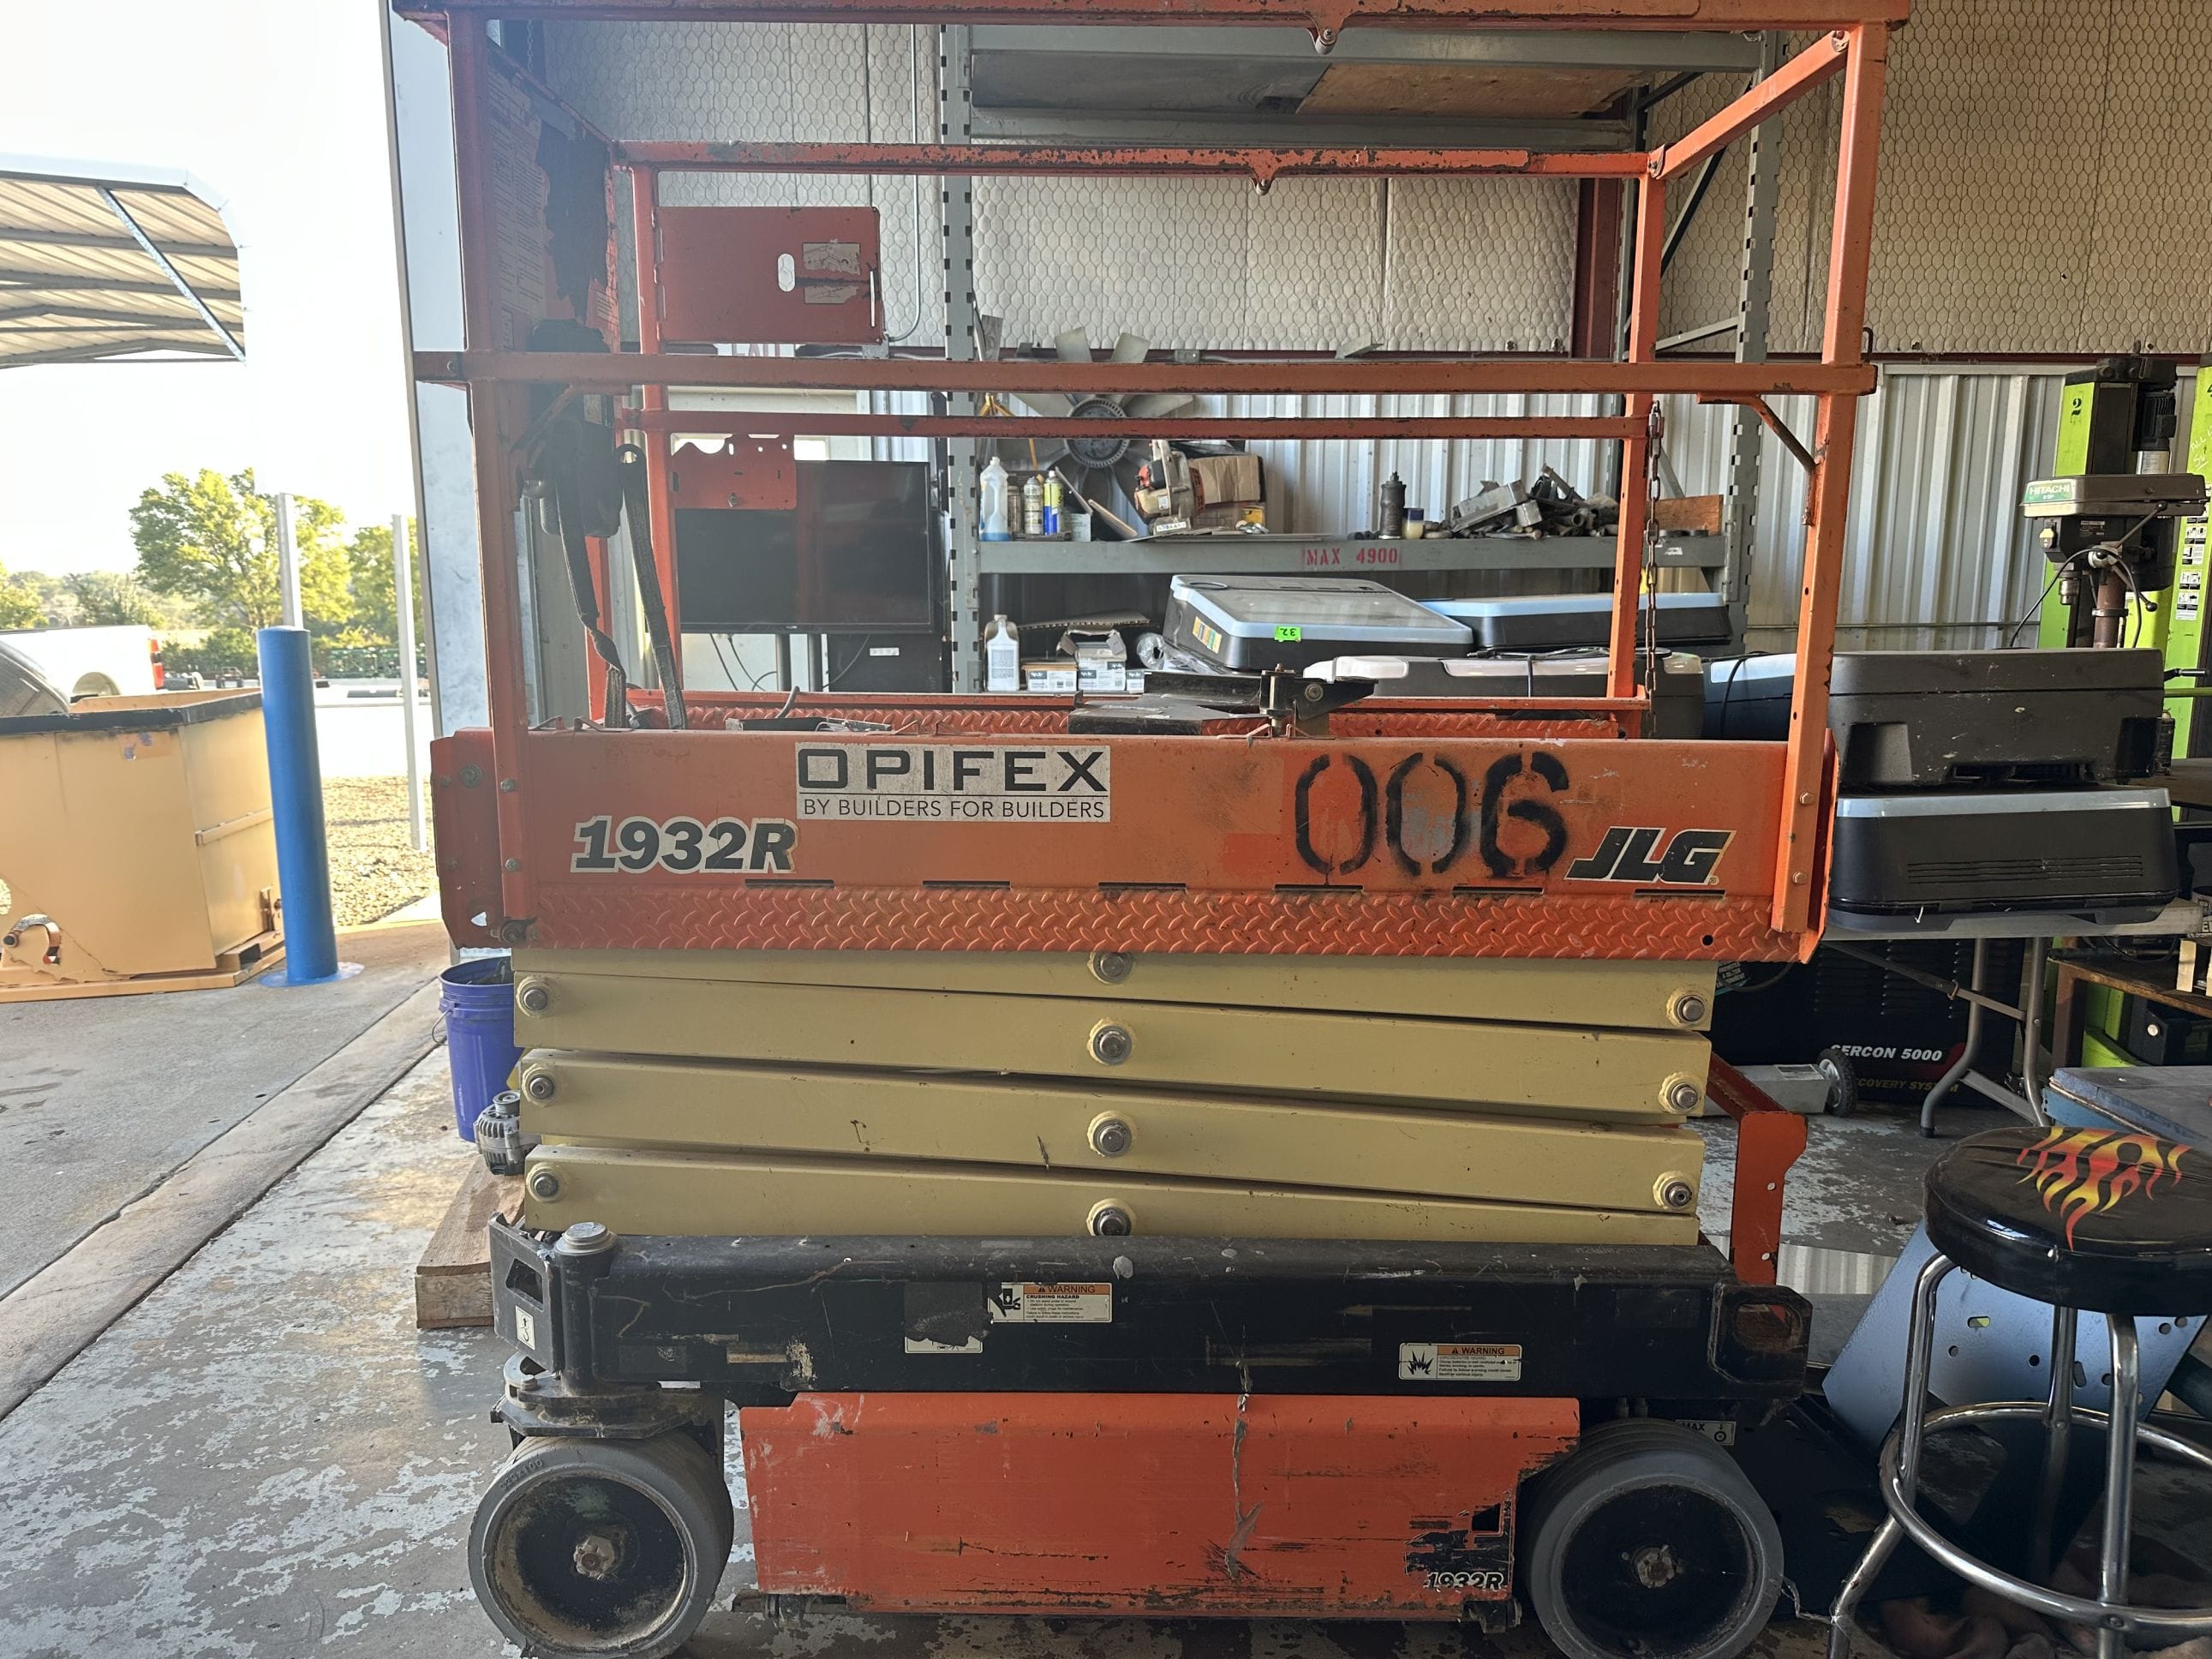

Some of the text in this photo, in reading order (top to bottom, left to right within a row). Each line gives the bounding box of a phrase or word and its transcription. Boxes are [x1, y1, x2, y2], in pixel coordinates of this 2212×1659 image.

[2071, 398, 2083, 416] 2
[2029, 484, 2070, 495] HITACHI
[1306, 548, 1398, 566] MAX 4900
[798, 748, 1107, 791] OPIFEX
[804, 799, 1105, 819] BY BUILDERS FOR BUILDERS
[1294, 752, 1570, 879] 006
[571, 816, 798, 873] 1932R
[1564, 826, 1736, 884] JLG
[1901, 1048, 1943, 1061] 5000
[1856, 1077, 1908, 1089] COVERY
[1425, 1572, 1504, 1591] 1932R
